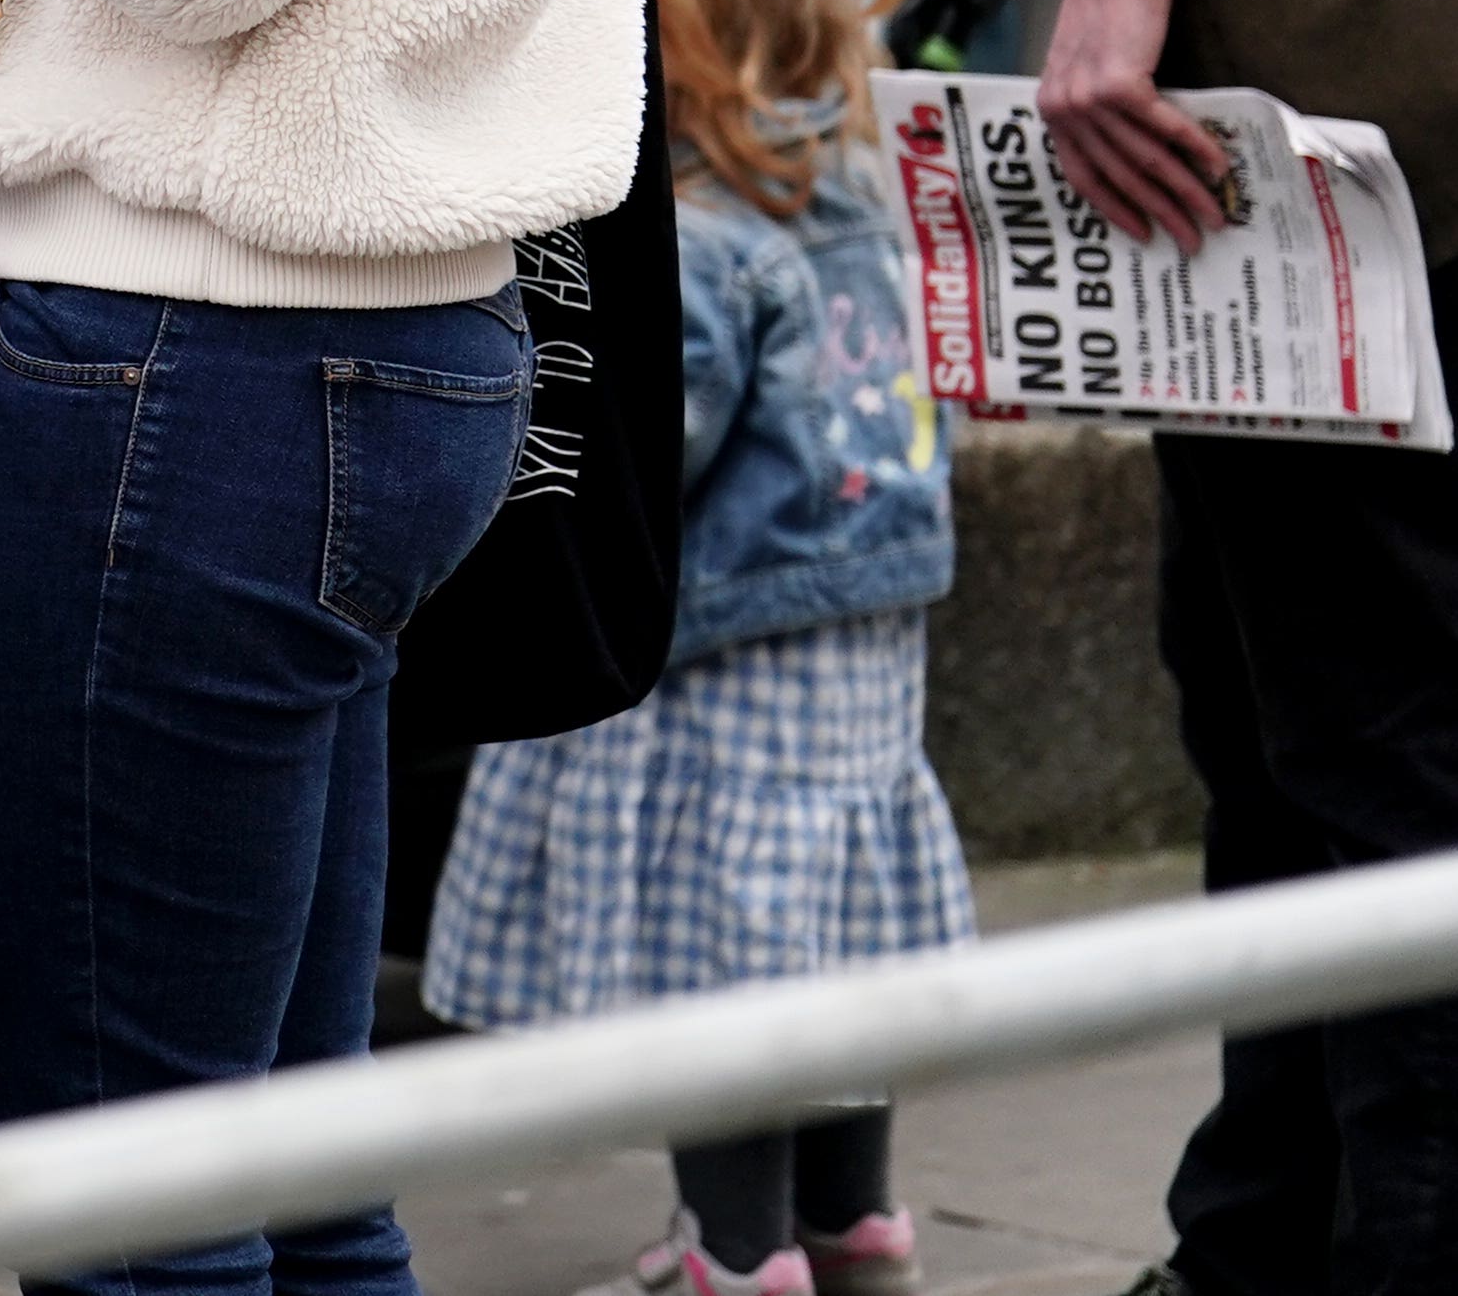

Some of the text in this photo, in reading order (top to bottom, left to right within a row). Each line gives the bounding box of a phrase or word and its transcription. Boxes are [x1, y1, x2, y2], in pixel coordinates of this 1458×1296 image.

[913, 167, 976, 396] Solidarity
[982, 106, 1066, 392] NO KINGS,
[1080, 330, 1122, 394] NO
